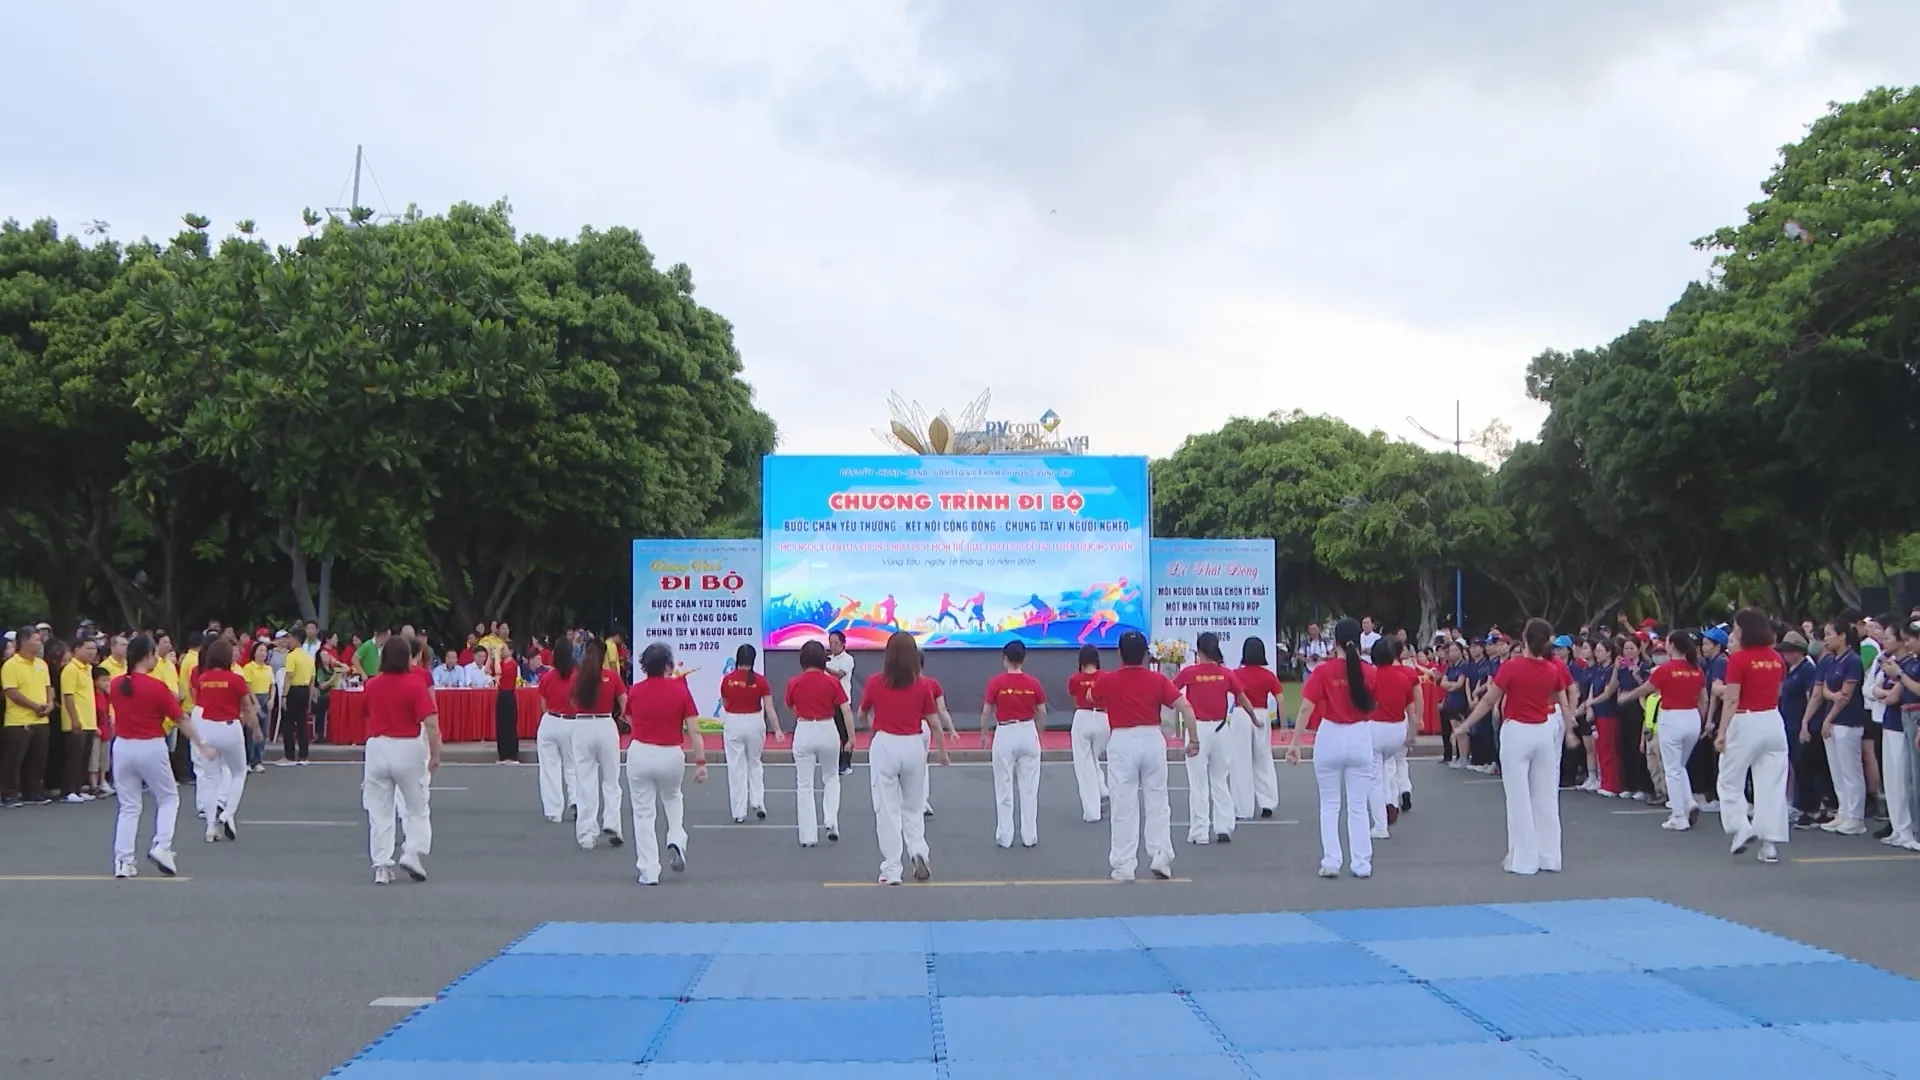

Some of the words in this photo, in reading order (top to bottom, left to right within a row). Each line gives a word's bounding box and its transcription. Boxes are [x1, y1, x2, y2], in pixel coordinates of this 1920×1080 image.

[940, 490, 1010, 511] TRÌNH
[1018, 493, 1043, 511] ĐI
[1052, 490, 1083, 514] BỘ
[1006, 519, 1036, 532] CHUNG
[1040, 519, 1054, 532] TAY
[987, 557, 996, 566] 10
[661, 576, 690, 590] ĐI
[702, 571, 744, 593] BỘ
[646, 627, 672, 637] CHUNG
[699, 641, 720, 651] 2026
